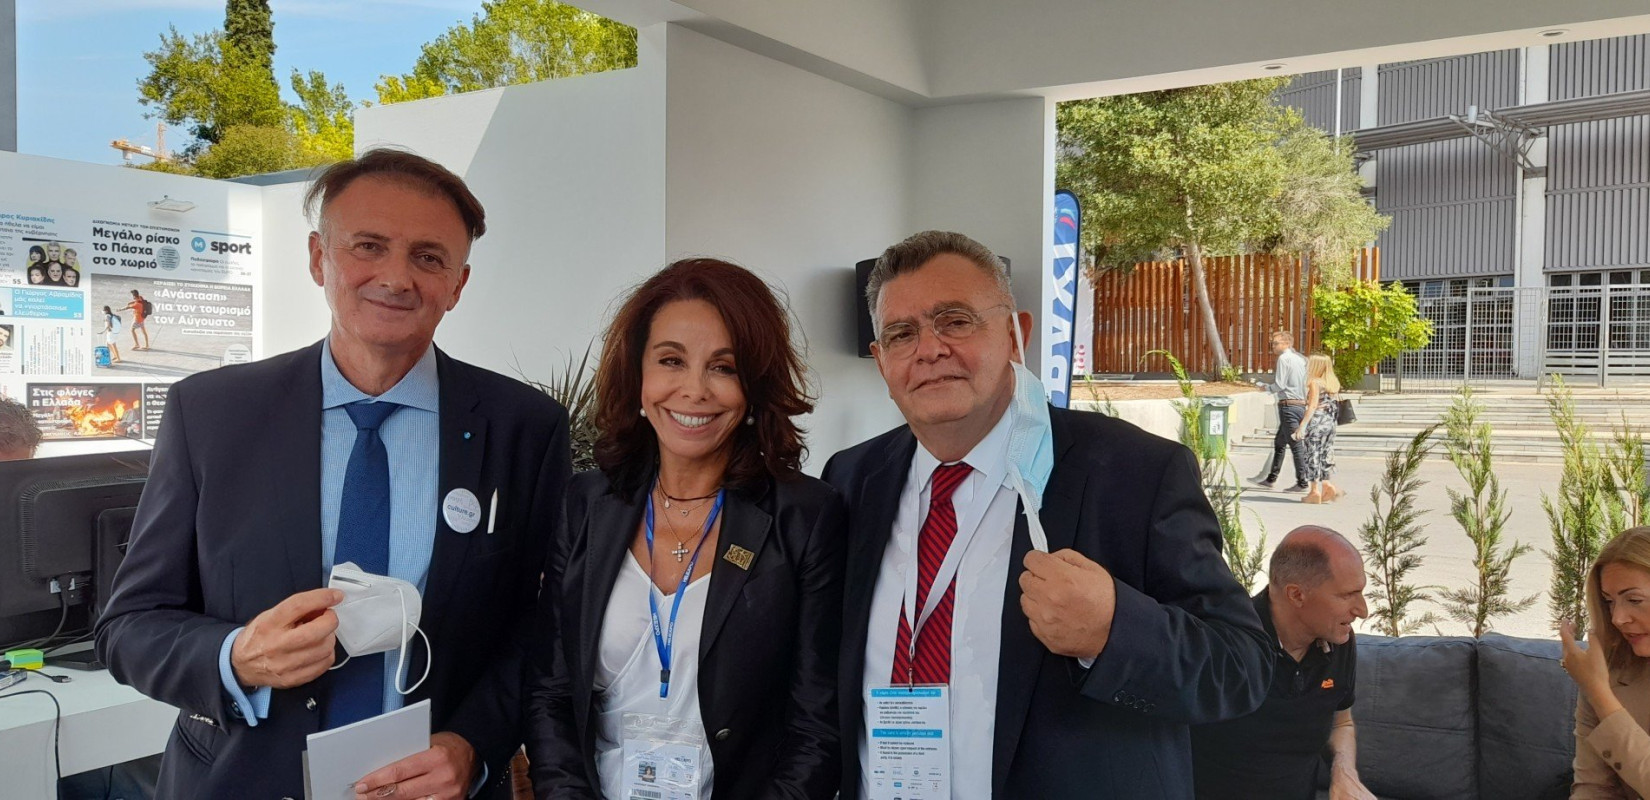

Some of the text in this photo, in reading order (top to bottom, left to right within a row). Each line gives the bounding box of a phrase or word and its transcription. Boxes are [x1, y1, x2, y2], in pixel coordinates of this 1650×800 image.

[92, 226, 180, 245] Μεγάλο ρίσκο
[92, 242, 153, 255] το Πάσχα
[210, 241, 252, 255] sport
[92, 256, 157, 270] στο χωριό
[153, 288, 227, 301] «Ανάσταση»
[154, 302, 251, 317] για τον τουρισμό
[153, 315, 236, 327] τον Αύγουστο
[32, 388, 95, 398] Στις φλόγες
